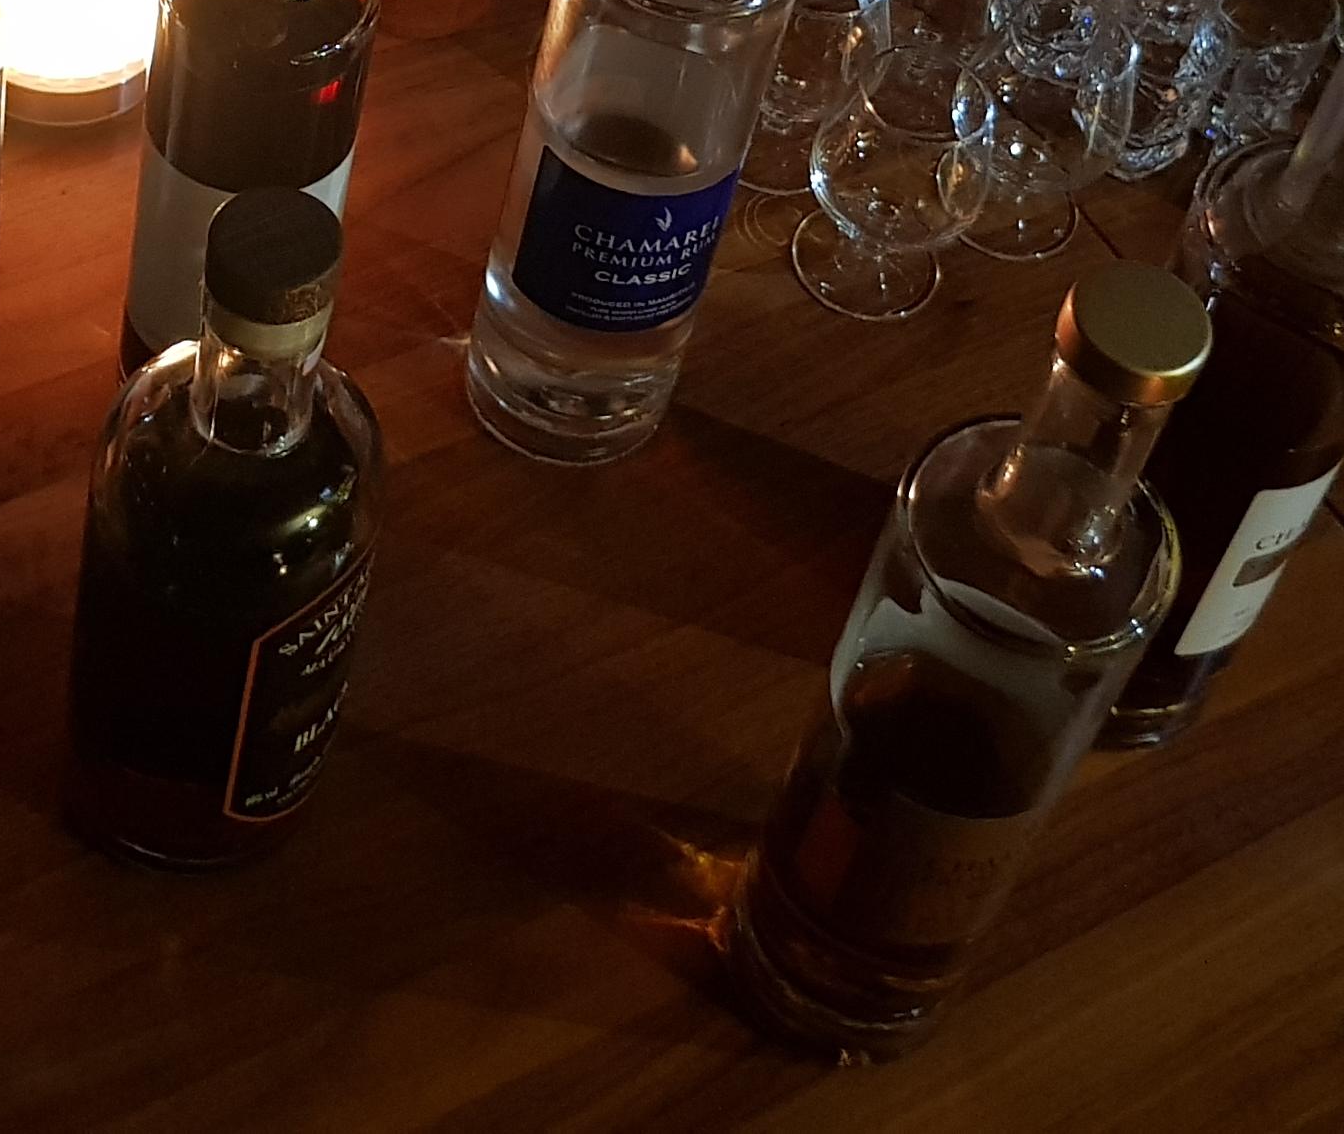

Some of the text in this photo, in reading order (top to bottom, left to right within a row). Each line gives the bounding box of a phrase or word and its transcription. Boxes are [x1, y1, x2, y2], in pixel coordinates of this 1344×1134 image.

[574, 215, 720, 253] CHAMAREL
[572, 240, 673, 268] PREMIUM
[595, 262, 692, 287] CLASSIC
[570, 290, 631, 309] PRODUCED
